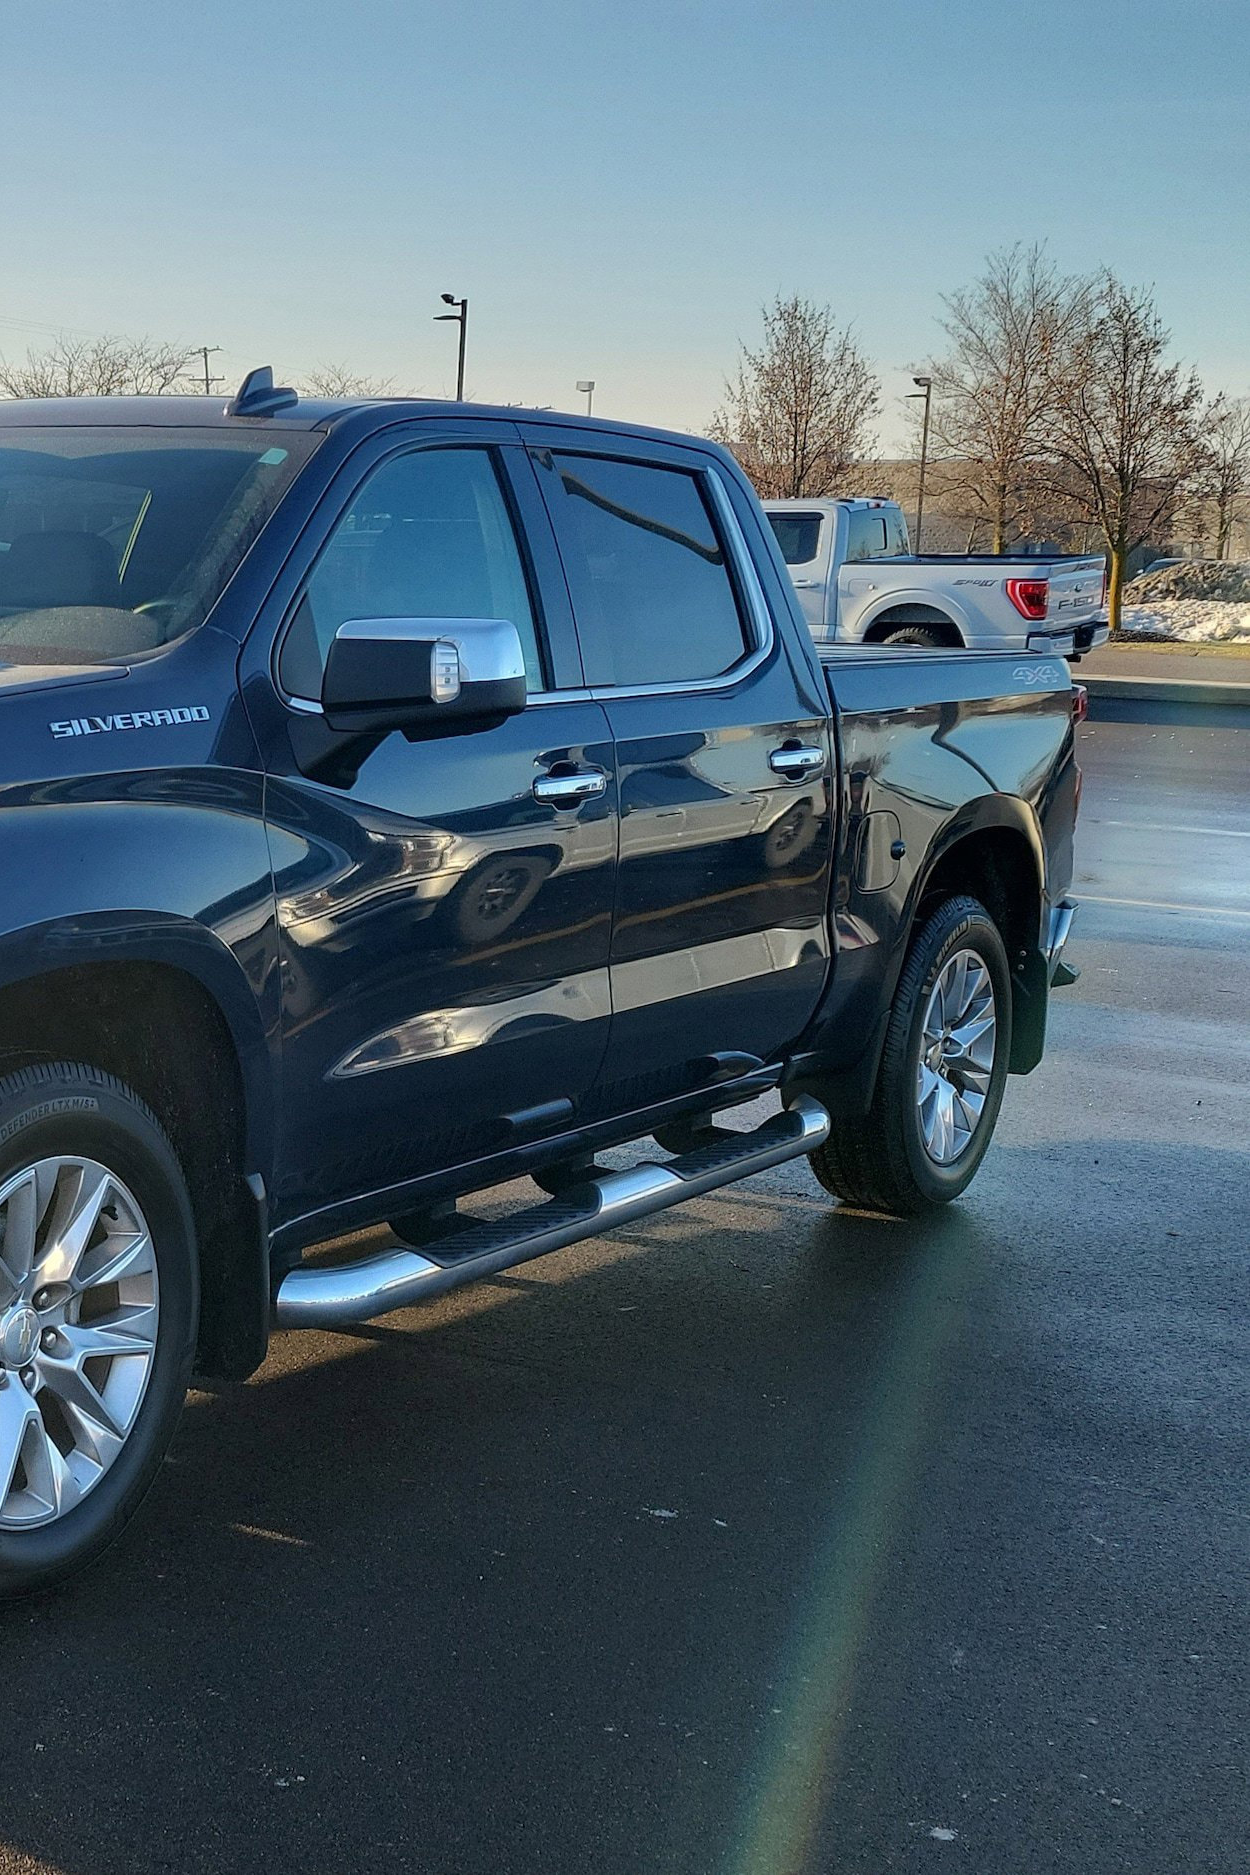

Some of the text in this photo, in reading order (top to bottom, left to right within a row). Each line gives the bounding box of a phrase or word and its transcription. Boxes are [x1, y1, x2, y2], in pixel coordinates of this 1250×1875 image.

[1058, 596, 1095, 610] F-150
[50, 705, 211, 739] SILVERADO
[0, 1103, 51, 1140] DEFENDER
[51, 1100, 70, 1113] LTX
